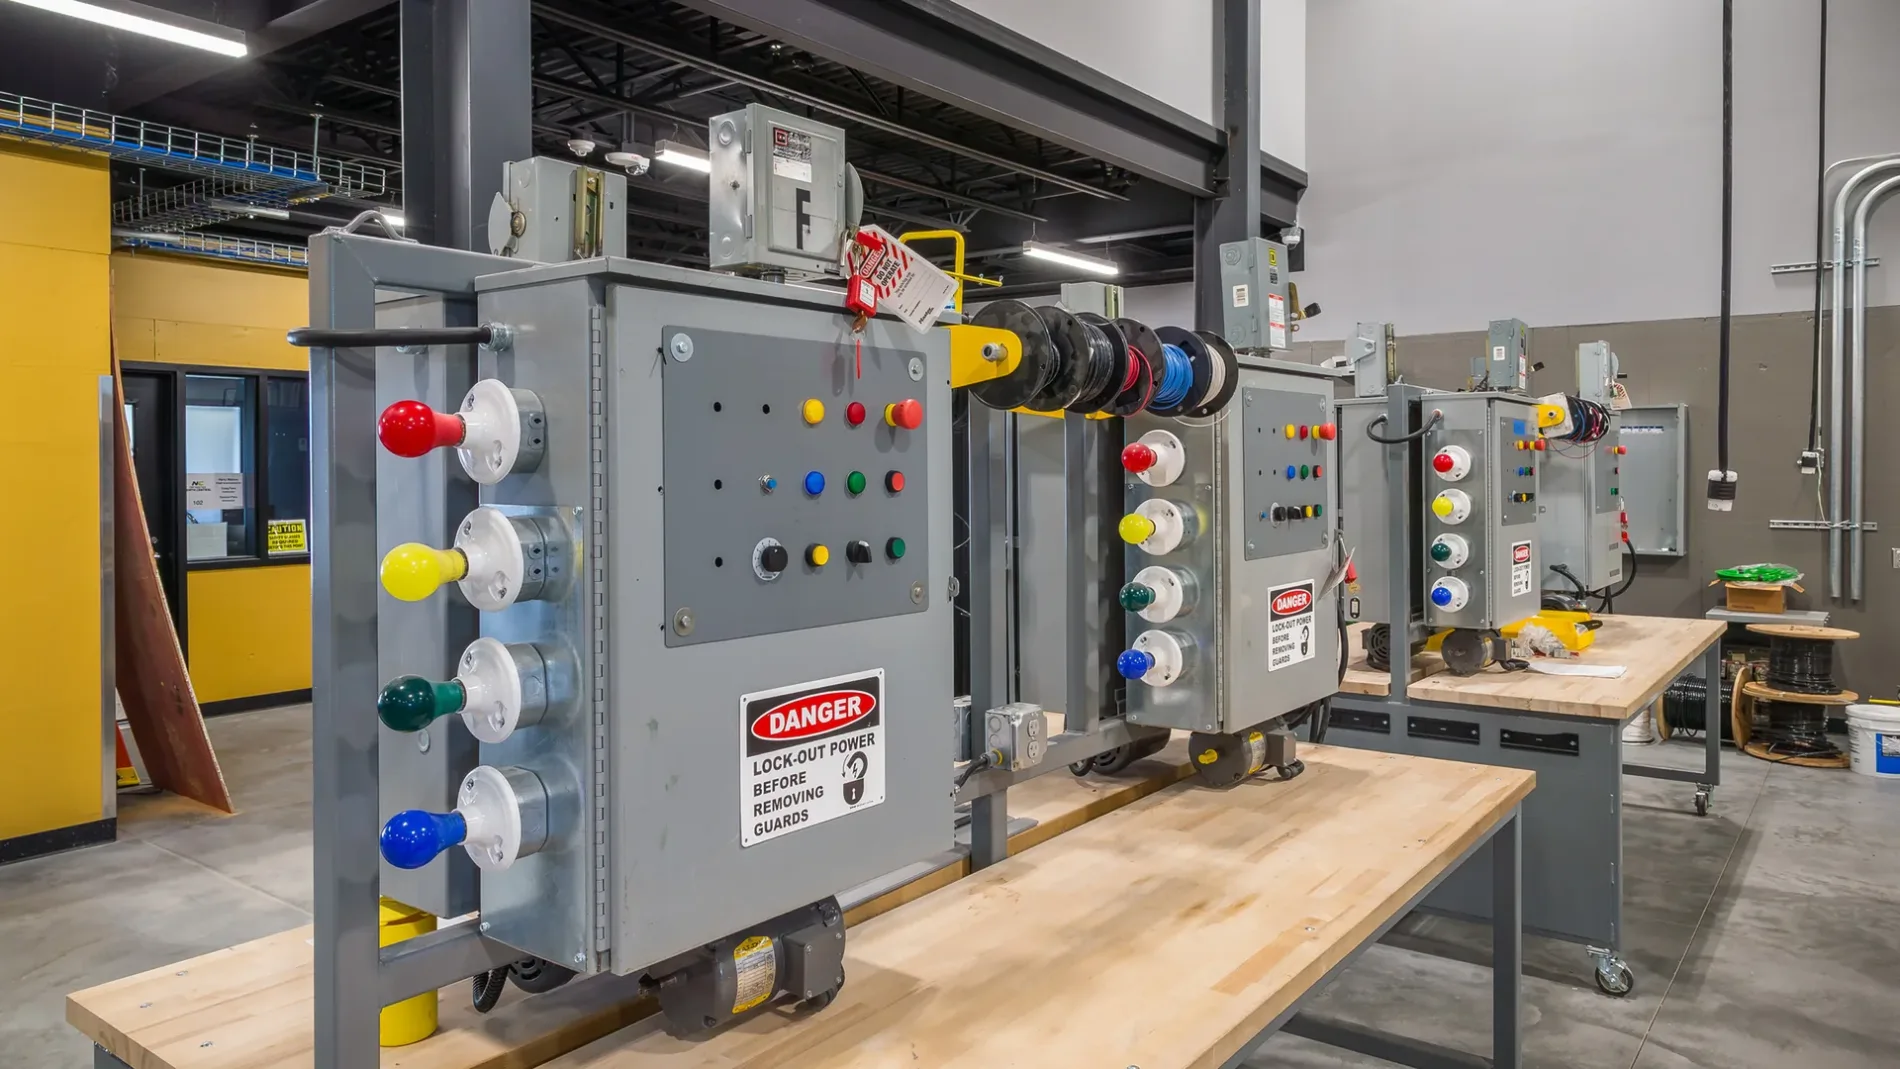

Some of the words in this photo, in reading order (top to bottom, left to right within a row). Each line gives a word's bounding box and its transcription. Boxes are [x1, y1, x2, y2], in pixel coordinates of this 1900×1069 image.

[796, 187, 811, 250] F
[861, 247, 882, 277] DANGE
[881, 260, 900, 287] OPERATE
[882, 258, 893, 273] NOT
[1276, 593, 1307, 611] DANGER
[1272, 619, 1295, 633] LOCK-OUT
[1296, 615, 1311, 627] POWER
[1272, 633, 1289, 644] BEFORE
[1272, 642, 1295, 655] REMOVING
[1272, 654, 1290, 667] GUARDS
[769, 696, 862, 735] DANGER
[753, 744, 826, 776] LOCK-OUT
[830, 732, 875, 756] POWER
[753, 771, 807, 797] BEFORE
[753, 785, 824, 817] REMOVING
[754, 809, 809, 837] GUARDS
